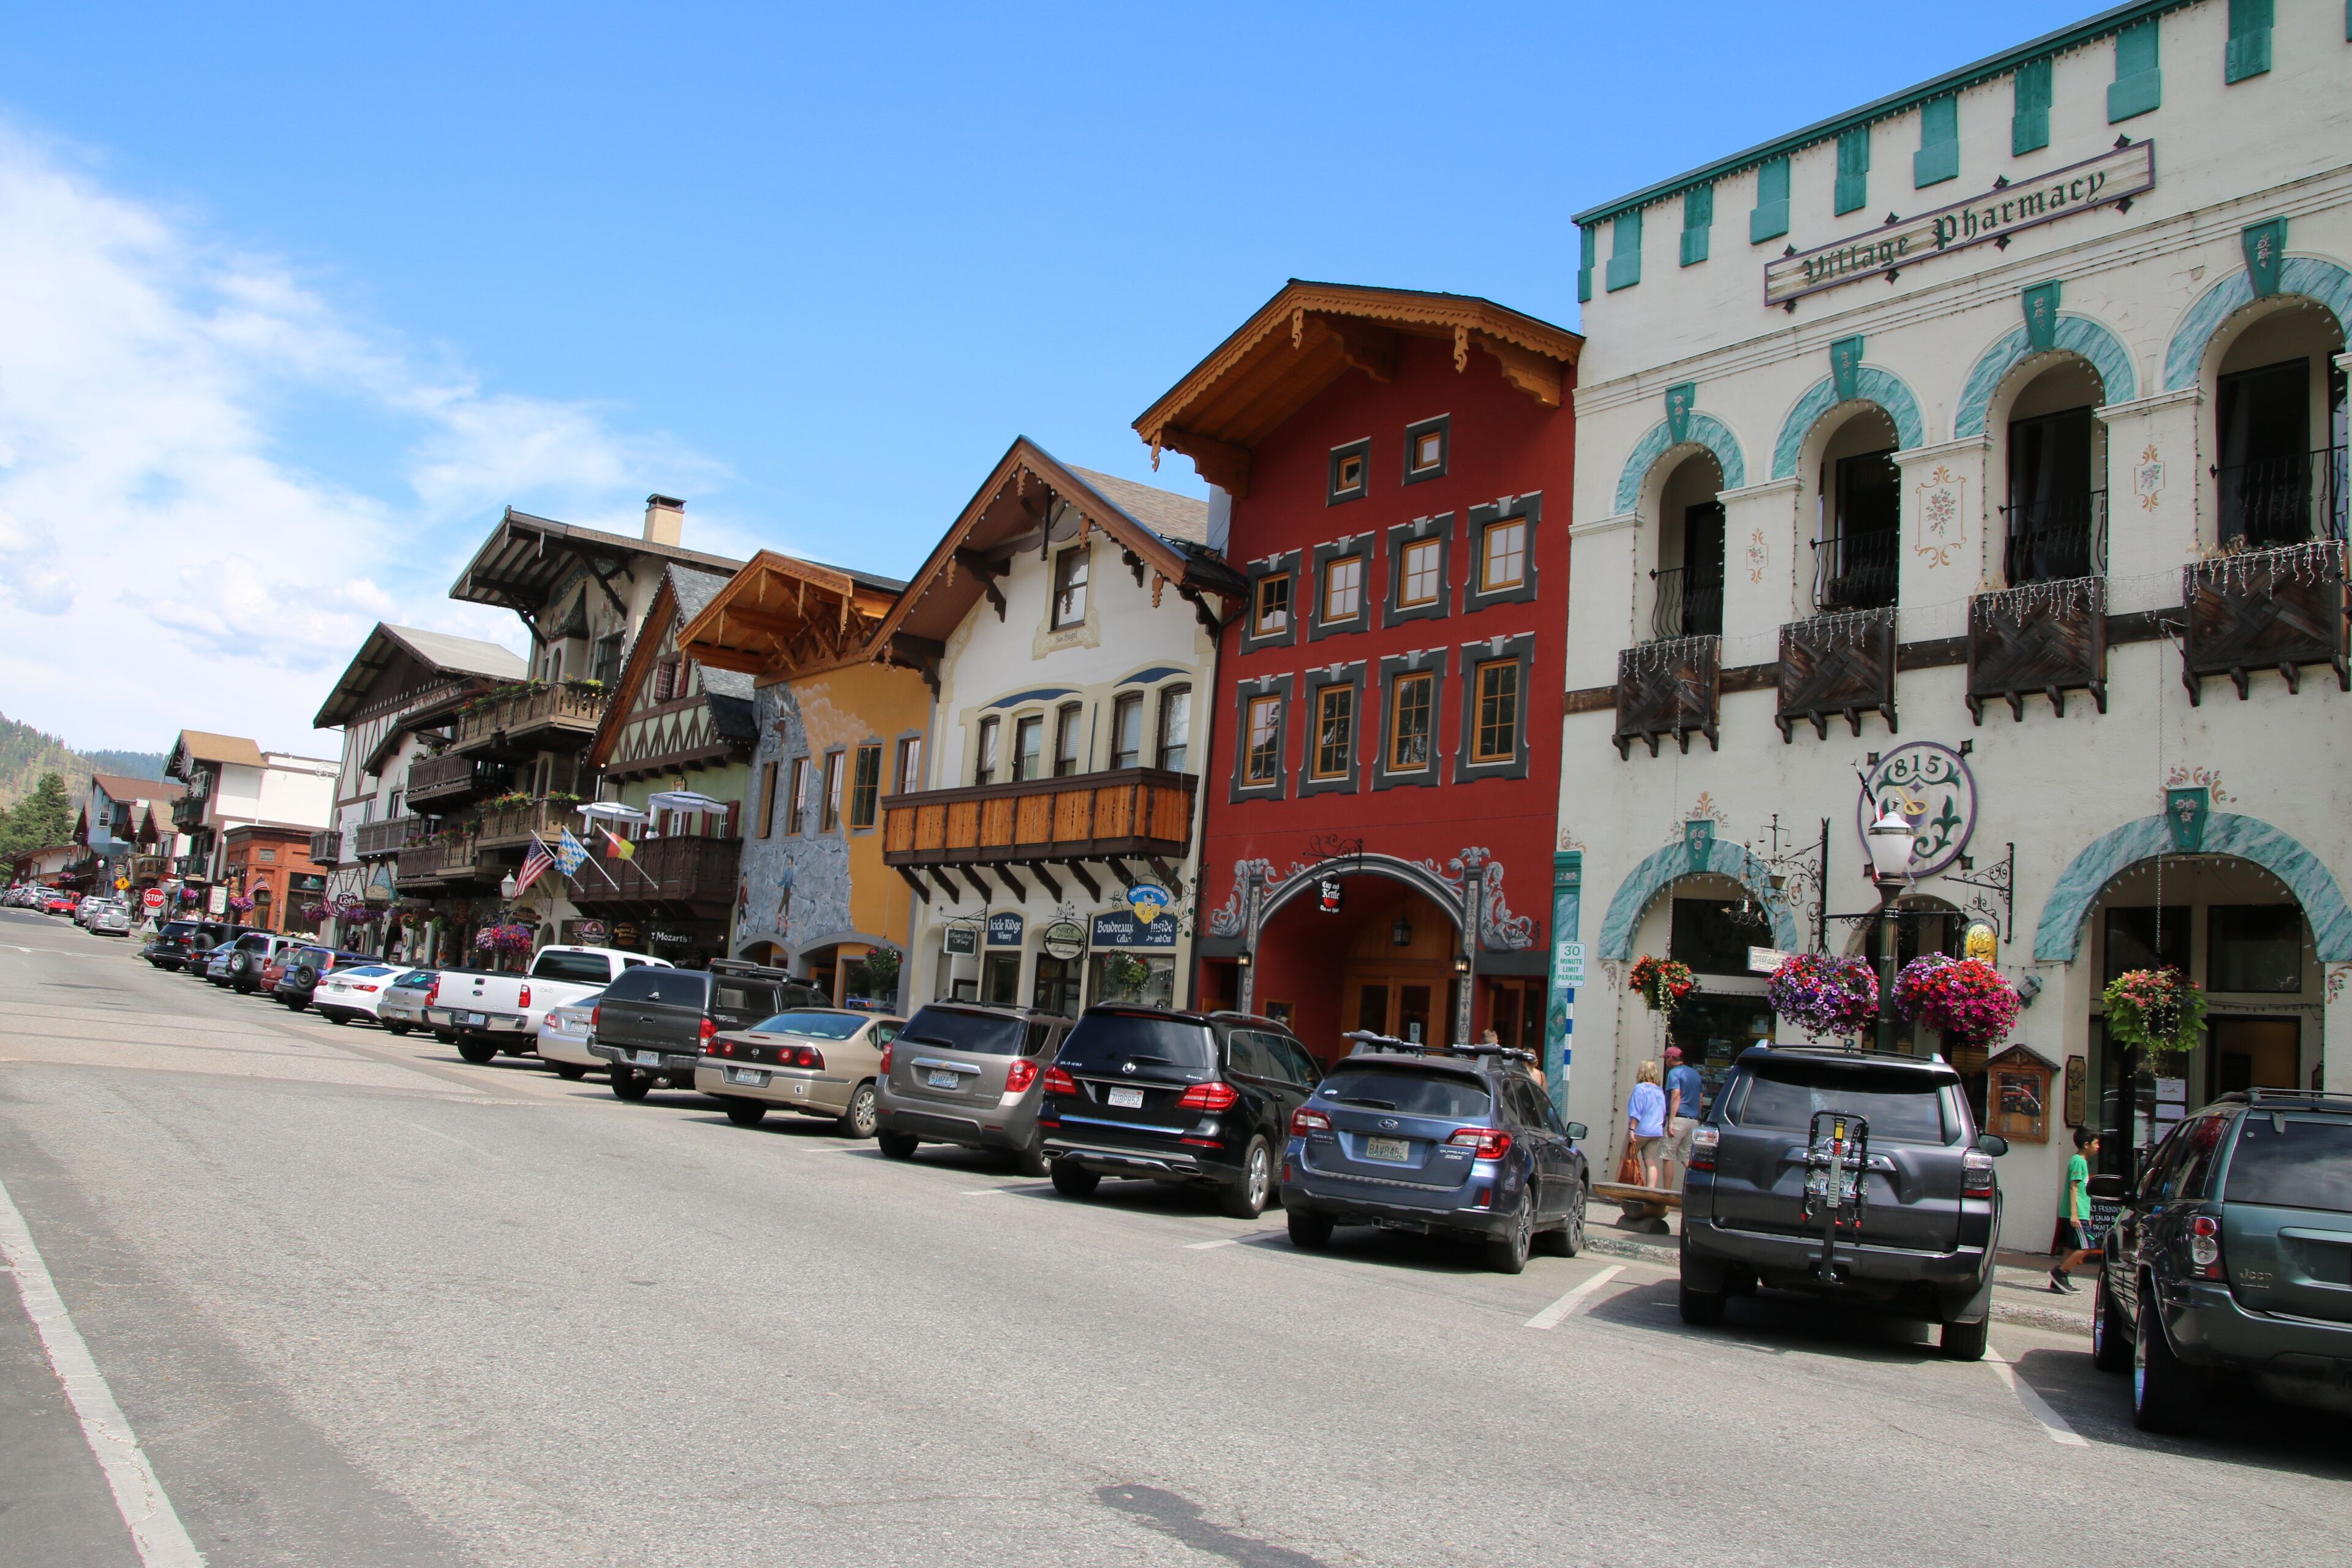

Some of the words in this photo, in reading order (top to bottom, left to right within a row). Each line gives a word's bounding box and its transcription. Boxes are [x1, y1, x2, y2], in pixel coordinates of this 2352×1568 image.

[1802, 236, 1909, 285] Village
[1931, 171, 2106, 251] Pharmacy
[1894, 754, 1942, 777] 815
[146, 894, 164, 902] STOP
[990, 919, 1004, 931] Icicle
[1005, 919, 1021, 933] Ridge
[1097, 921, 1134, 933] Boudreaux
[1151, 920, 1172, 932] Inside
[656, 932, 687, 943] Mozart's
[997, 932, 1012, 941] Winery
[1163, 934, 1171, 943] Out
[1564, 946, 1580, 956] 30
[1112, 1094, 1140, 1106] 7UBP852
[2239, 1268, 2272, 1280] Jeep
